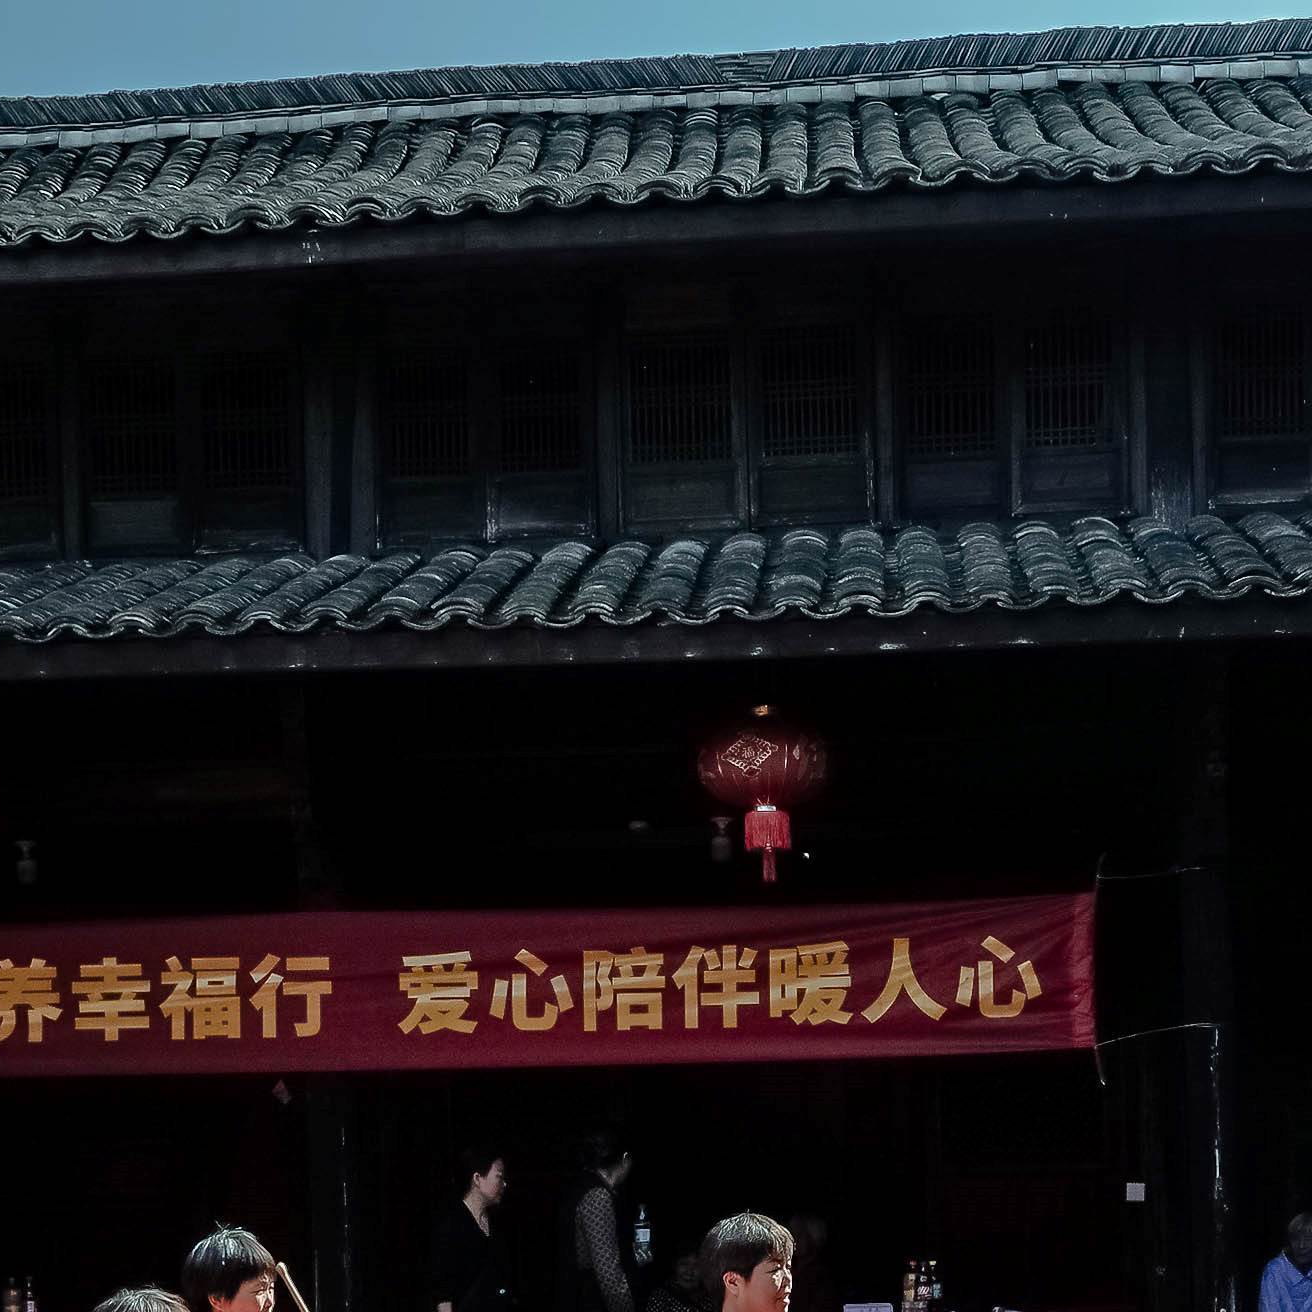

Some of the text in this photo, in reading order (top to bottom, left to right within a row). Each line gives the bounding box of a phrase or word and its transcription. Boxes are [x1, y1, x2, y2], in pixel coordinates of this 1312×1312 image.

[396, 935, 1043, 1036] 爱心陪伴暖人心
